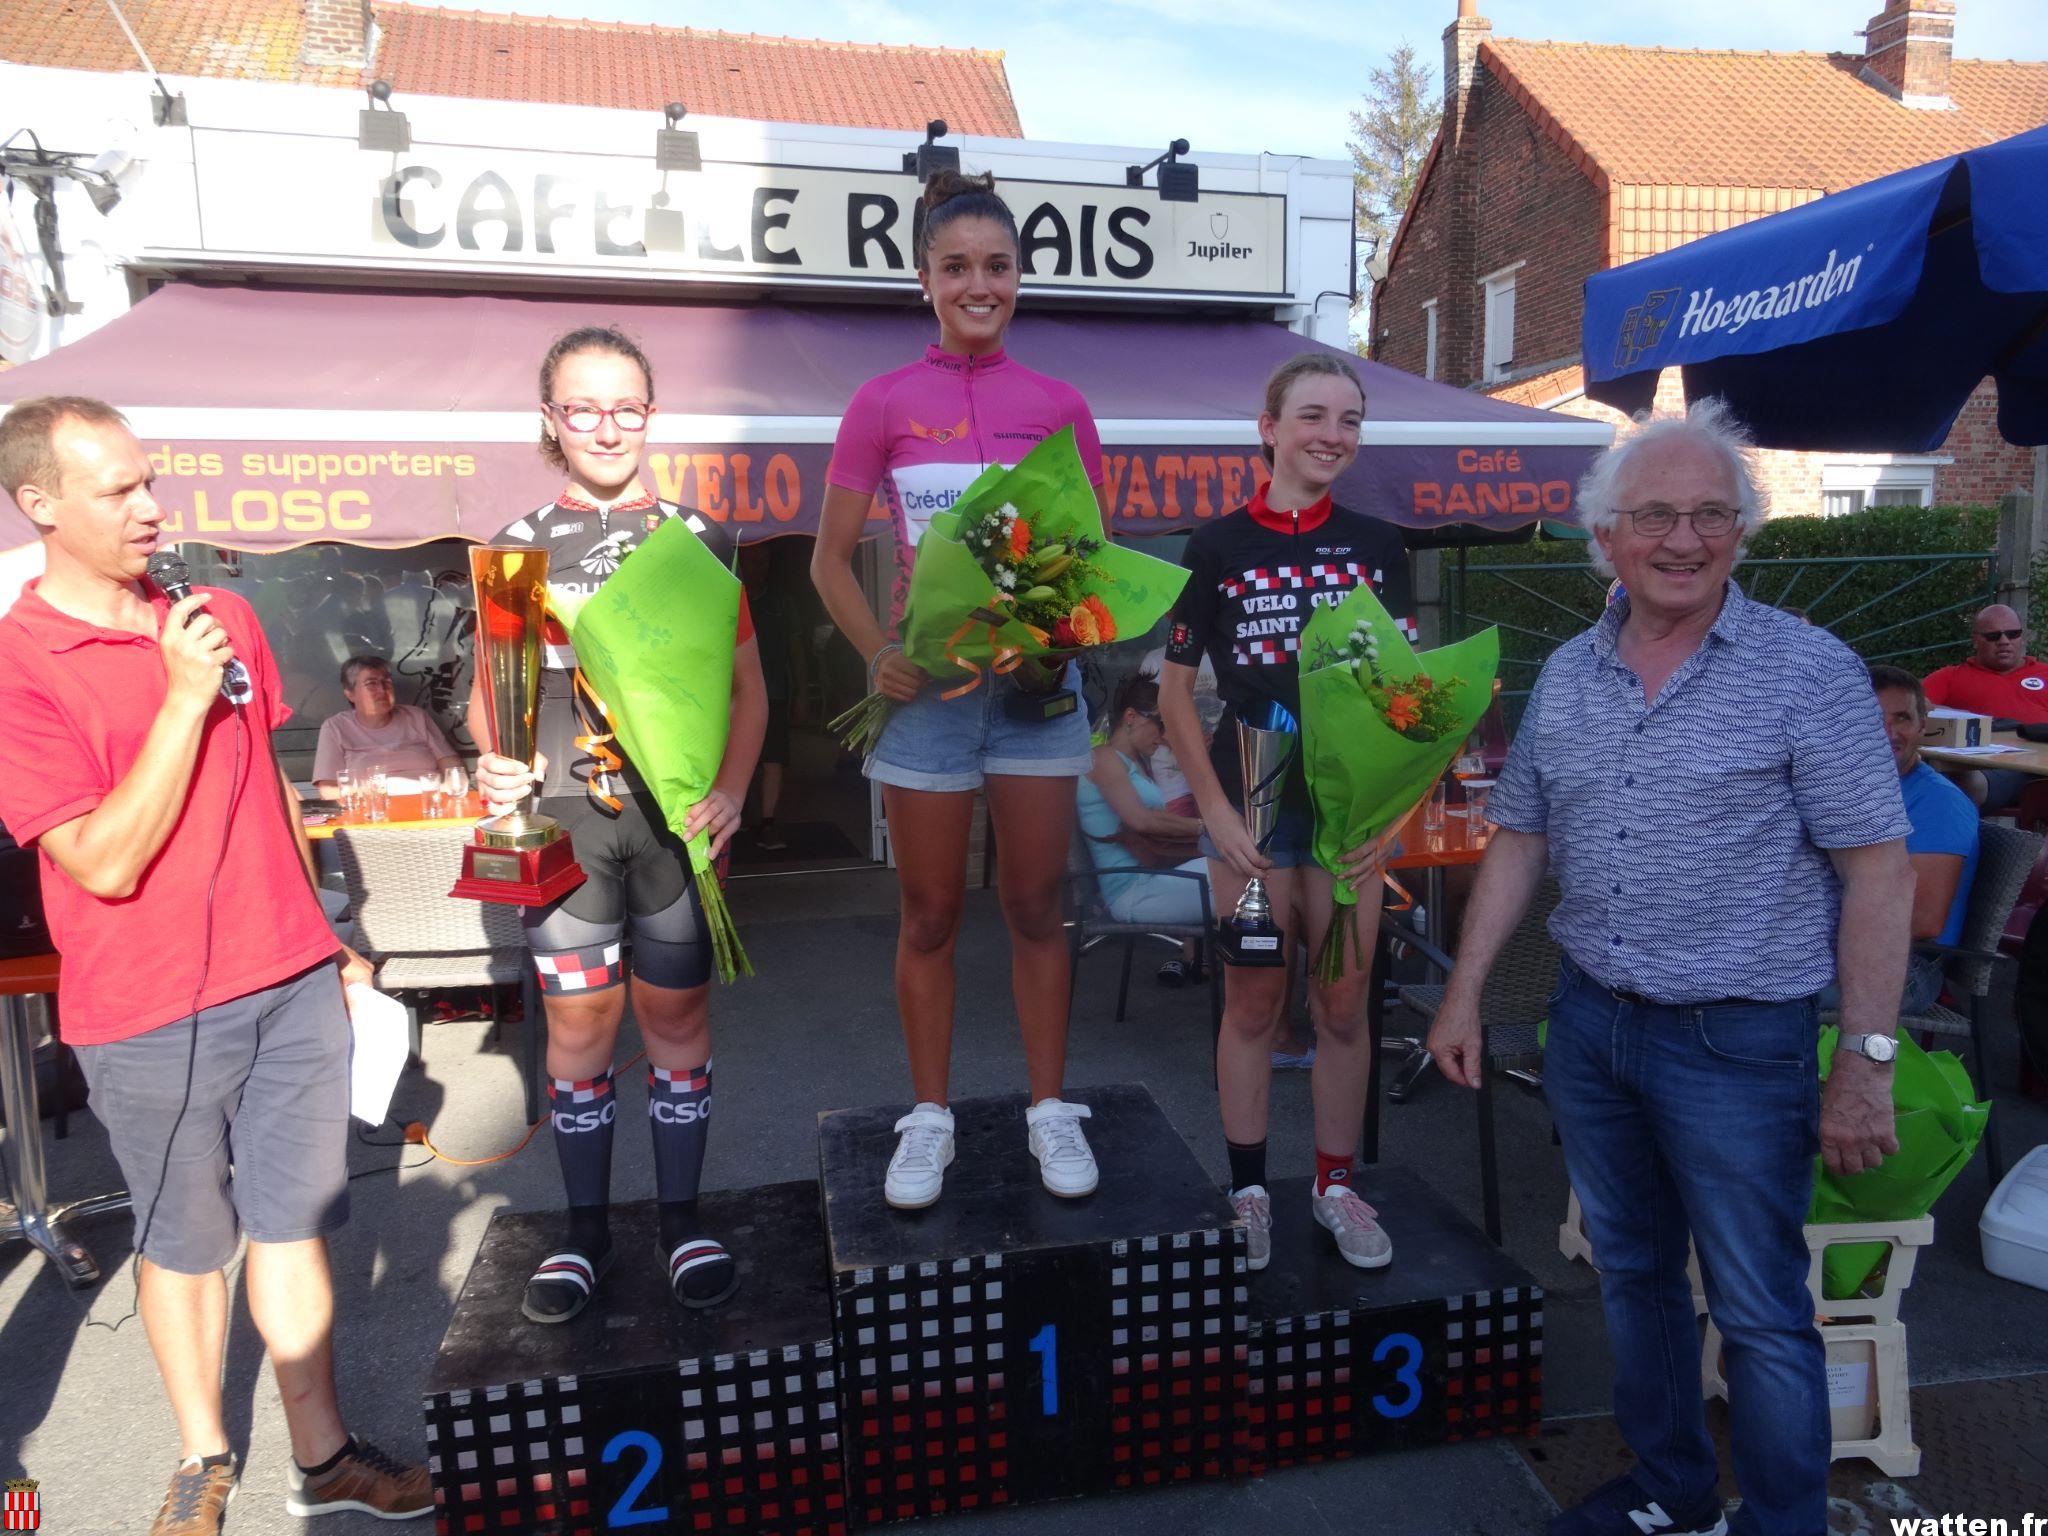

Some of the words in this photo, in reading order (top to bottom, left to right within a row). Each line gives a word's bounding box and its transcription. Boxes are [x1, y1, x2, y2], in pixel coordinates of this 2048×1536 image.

[847, 192, 1154, 280] RAIS
[1187, 241, 1253, 262] Jupiler
[1679, 250, 1862, 338] Hoegaarden
[993, 432, 1043, 442] SHIMANO
[149, 445, 224, 476] des
[242, 450, 476, 484] supporters
[1457, 448, 1521, 473] Café
[648, 453, 801, 522] VELO
[1413, 480, 1572, 515] RANDO
[193, 490, 372, 532] LOSC
[1242, 594, 1297, 614] VELO
[1236, 616, 1300, 638] SAINT
[1029, 1324, 1058, 1415] 1
[1372, 1333, 1423, 1418] 3
[602, 1430, 669, 1528] 2
